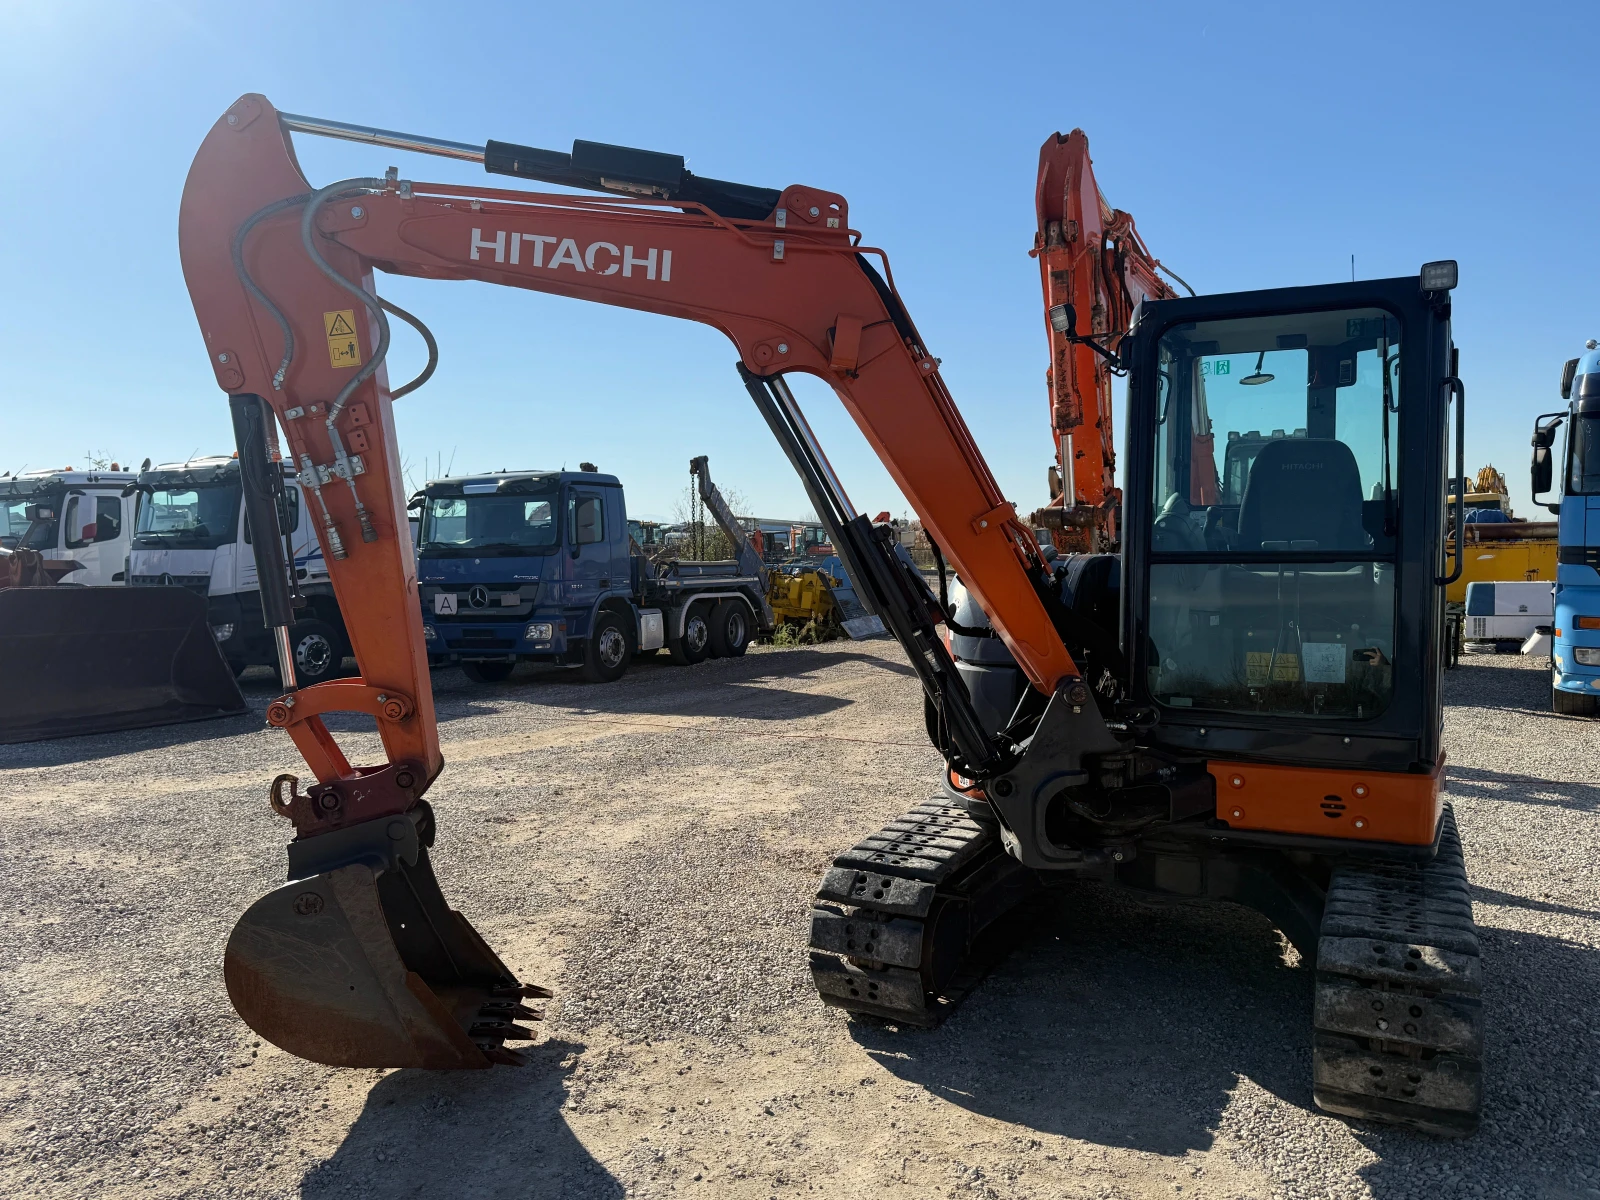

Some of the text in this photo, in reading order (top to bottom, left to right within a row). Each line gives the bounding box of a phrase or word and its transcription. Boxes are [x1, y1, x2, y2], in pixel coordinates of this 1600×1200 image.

[470, 228, 672, 282] HITACHI
[1281, 462, 1323, 470] HITACHI
[440, 597, 452, 612] A
